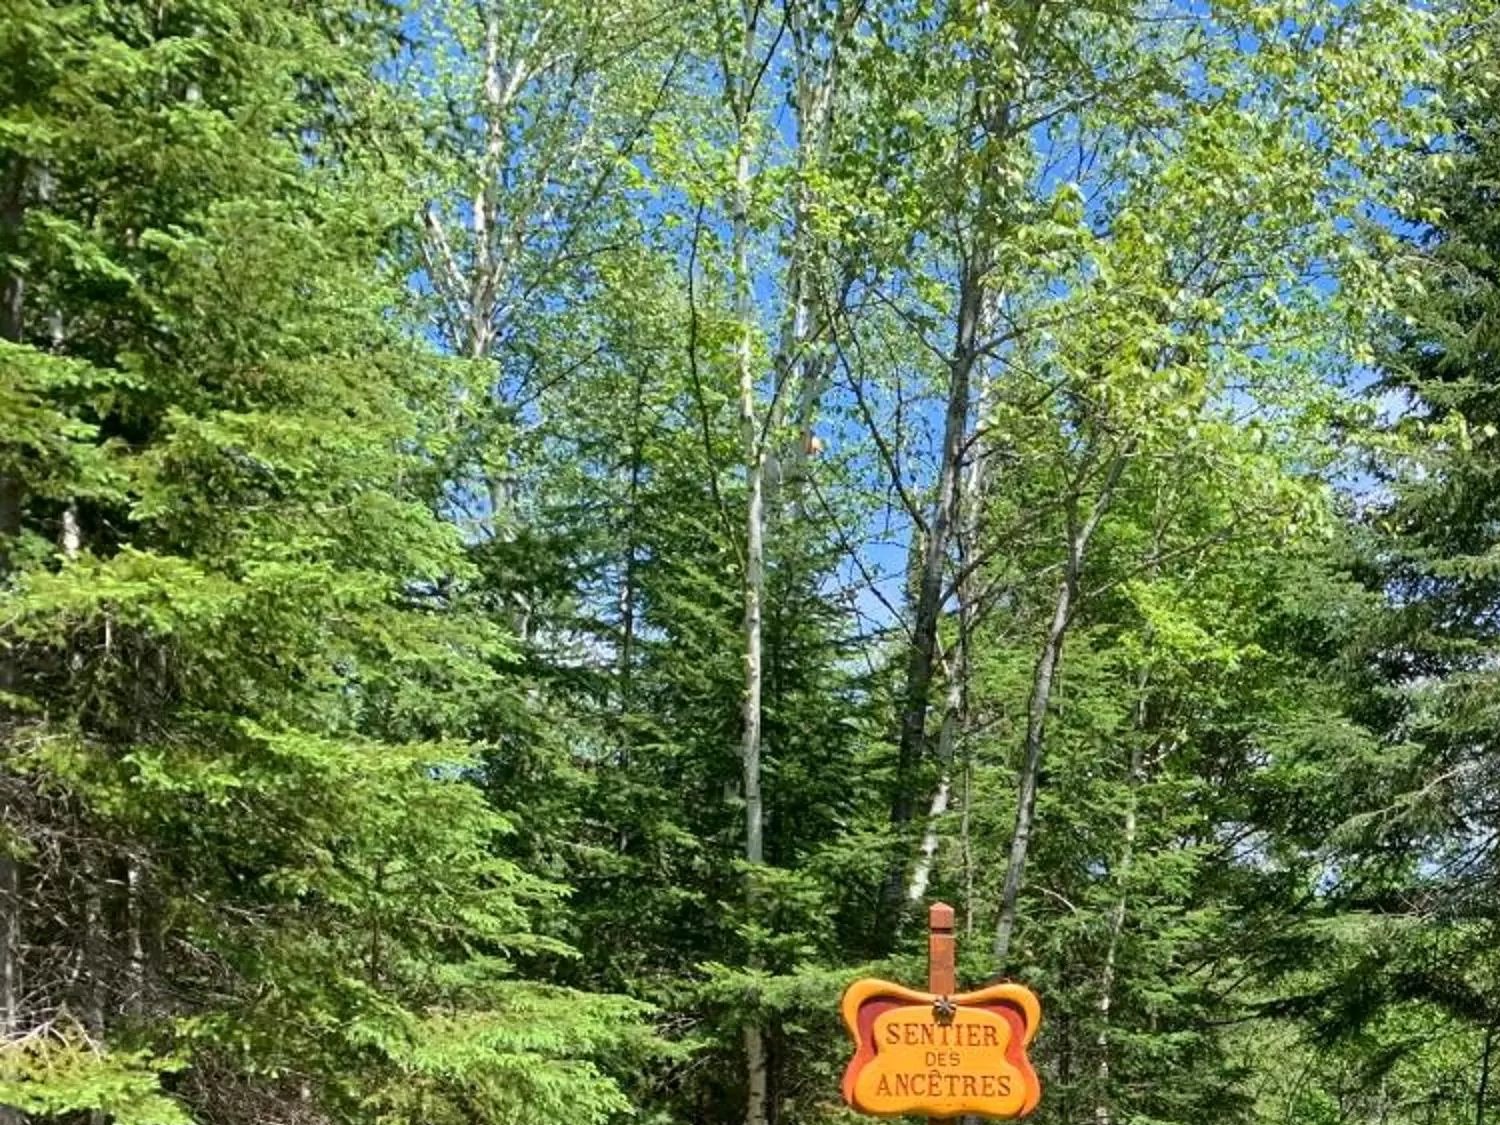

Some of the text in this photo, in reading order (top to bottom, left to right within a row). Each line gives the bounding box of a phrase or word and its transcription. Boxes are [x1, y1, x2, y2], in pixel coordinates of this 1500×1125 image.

[885, 1022, 999, 1047] SENTIER
[925, 1051, 961, 1067] DES
[876, 1069, 1011, 1097] ANCÊTRES
